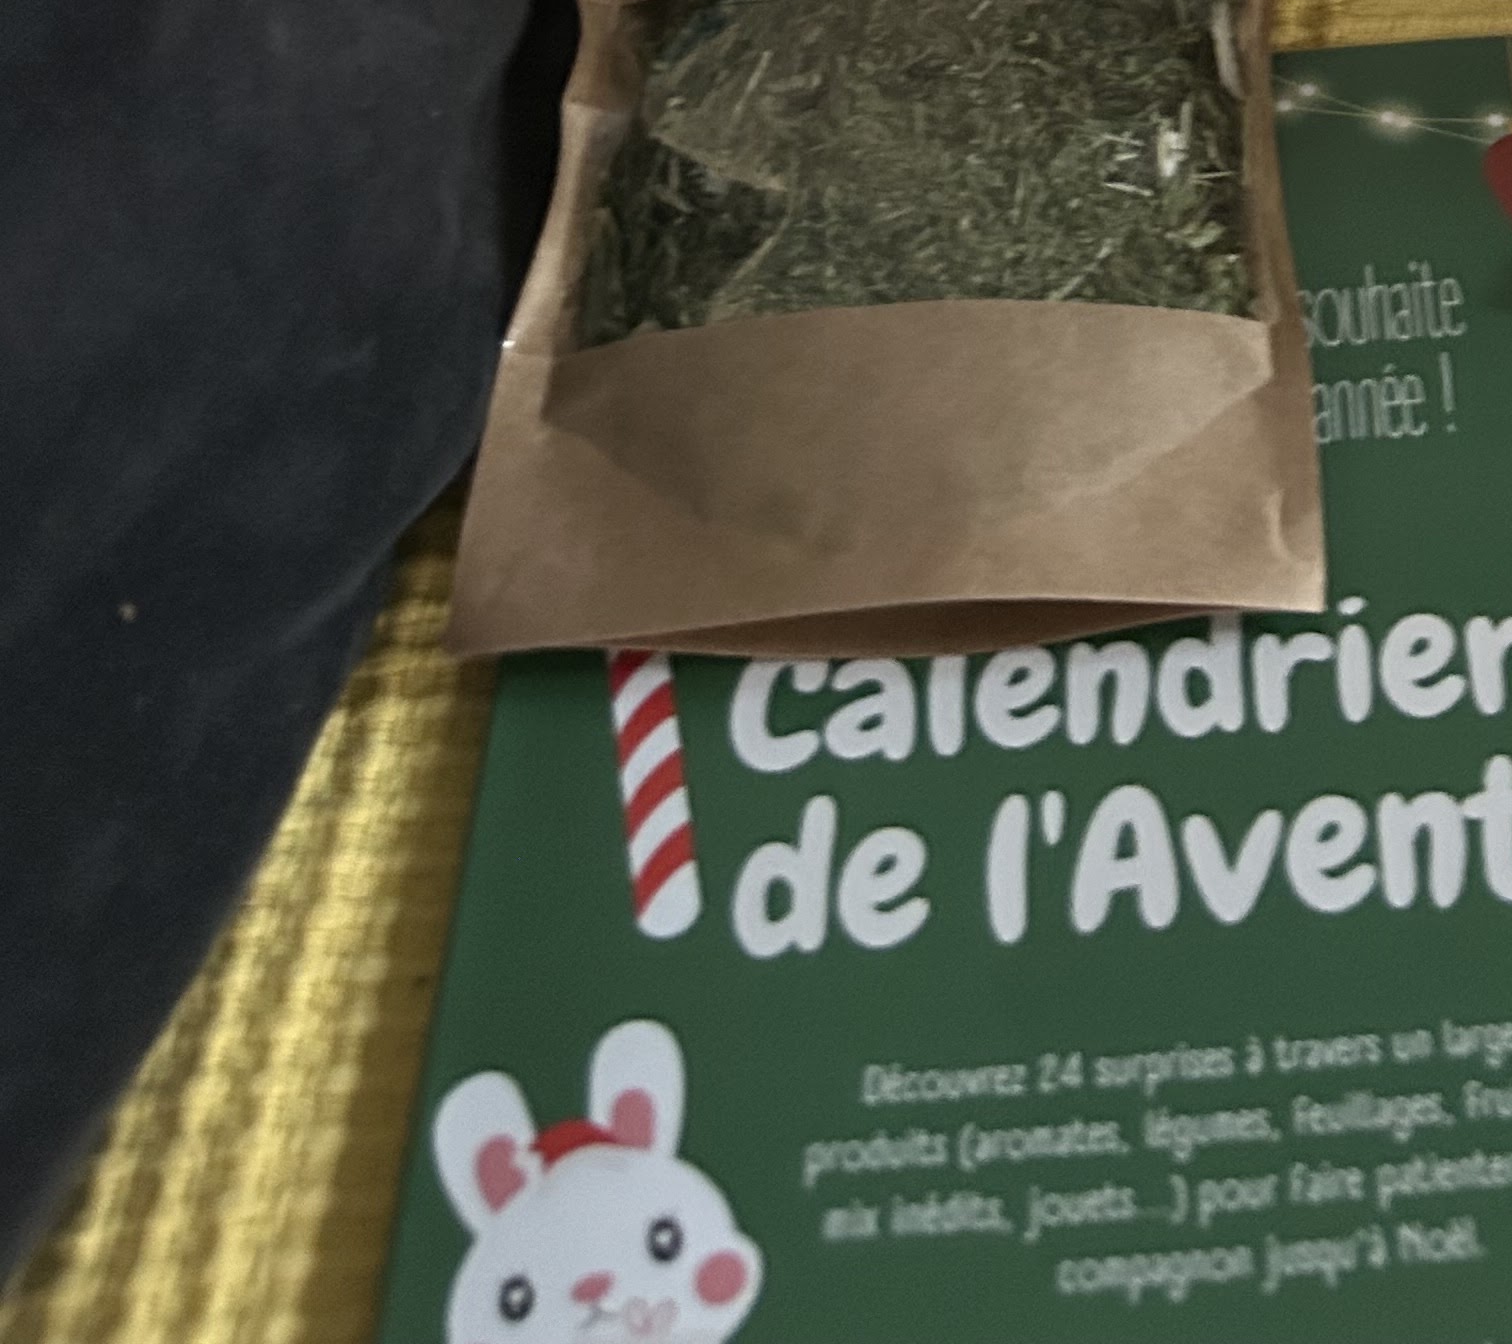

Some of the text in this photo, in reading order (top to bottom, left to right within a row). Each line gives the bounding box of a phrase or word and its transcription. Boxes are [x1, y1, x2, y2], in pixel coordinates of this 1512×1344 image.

[1311, 362, 1428, 443] année
[731, 794, 933, 960] de
[1037, 1050, 1083, 1094] 24
[1094, 1040, 1236, 1100] surprises
[1245, 1034, 1265, 1076] à
[1272, 1033, 1383, 1075] travers
[1391, 1029, 1435, 1062] un
[803, 1127, 948, 1189] produits
[1198, 1174, 1279, 1231] pour
[1288, 1160, 1365, 1205] faire
[1056, 1244, 1255, 1305] compagnon
